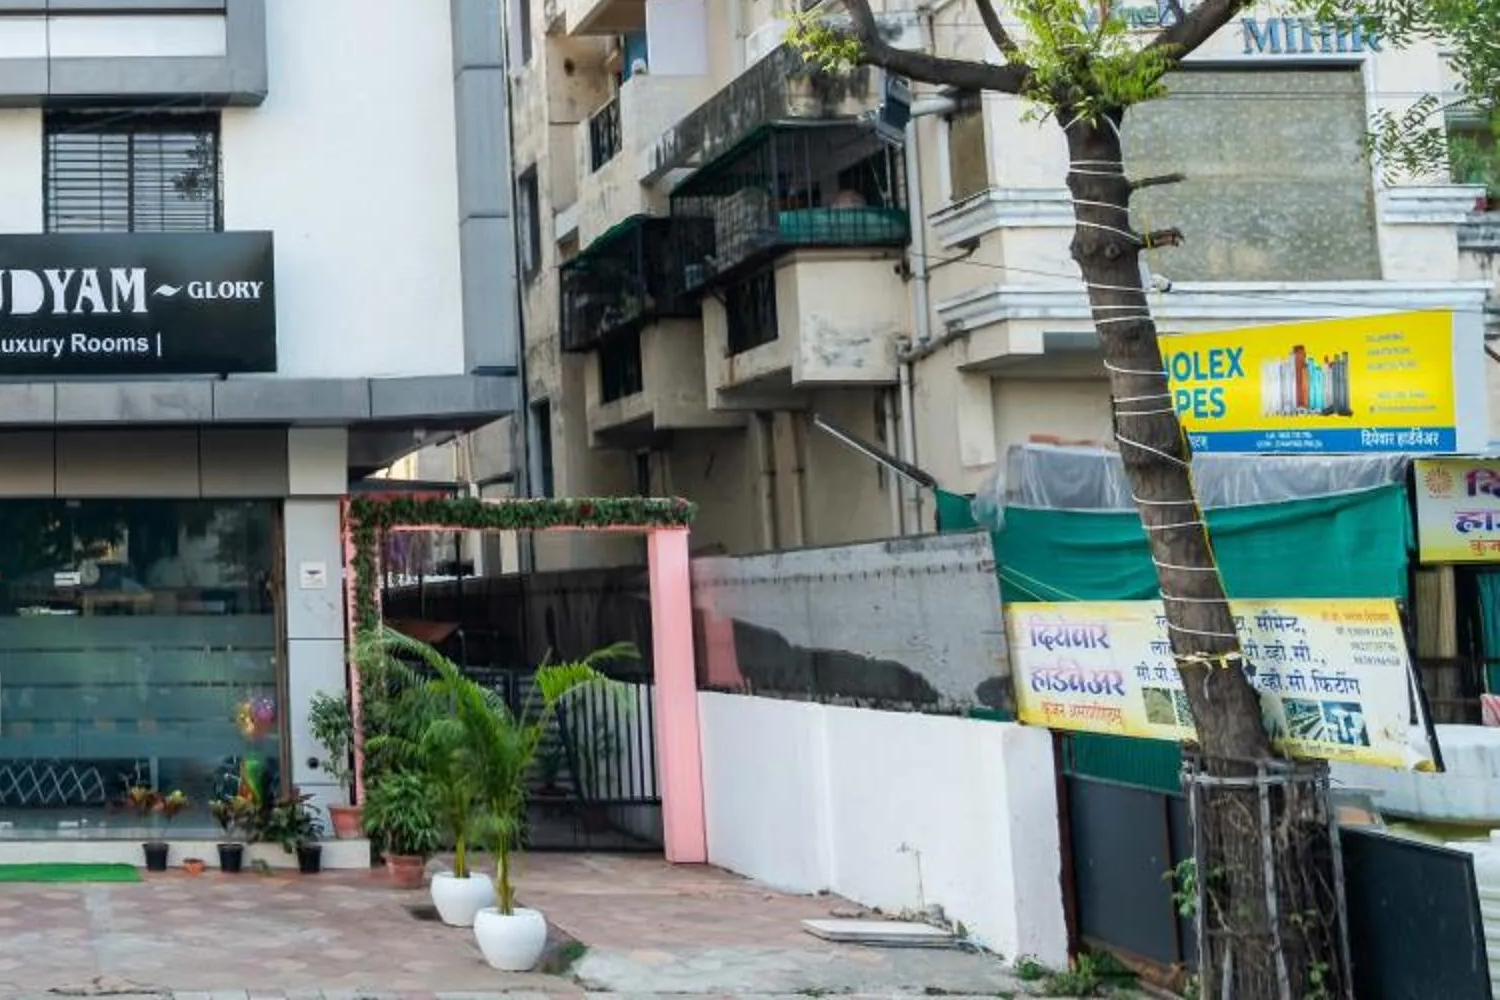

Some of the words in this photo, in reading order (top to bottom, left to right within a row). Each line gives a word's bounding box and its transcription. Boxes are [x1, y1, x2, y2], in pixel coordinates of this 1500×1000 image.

[187, 280, 265, 299] GLORY
[72, 333, 149, 353] Rooms
[1174, 386, 1226, 418] PES
